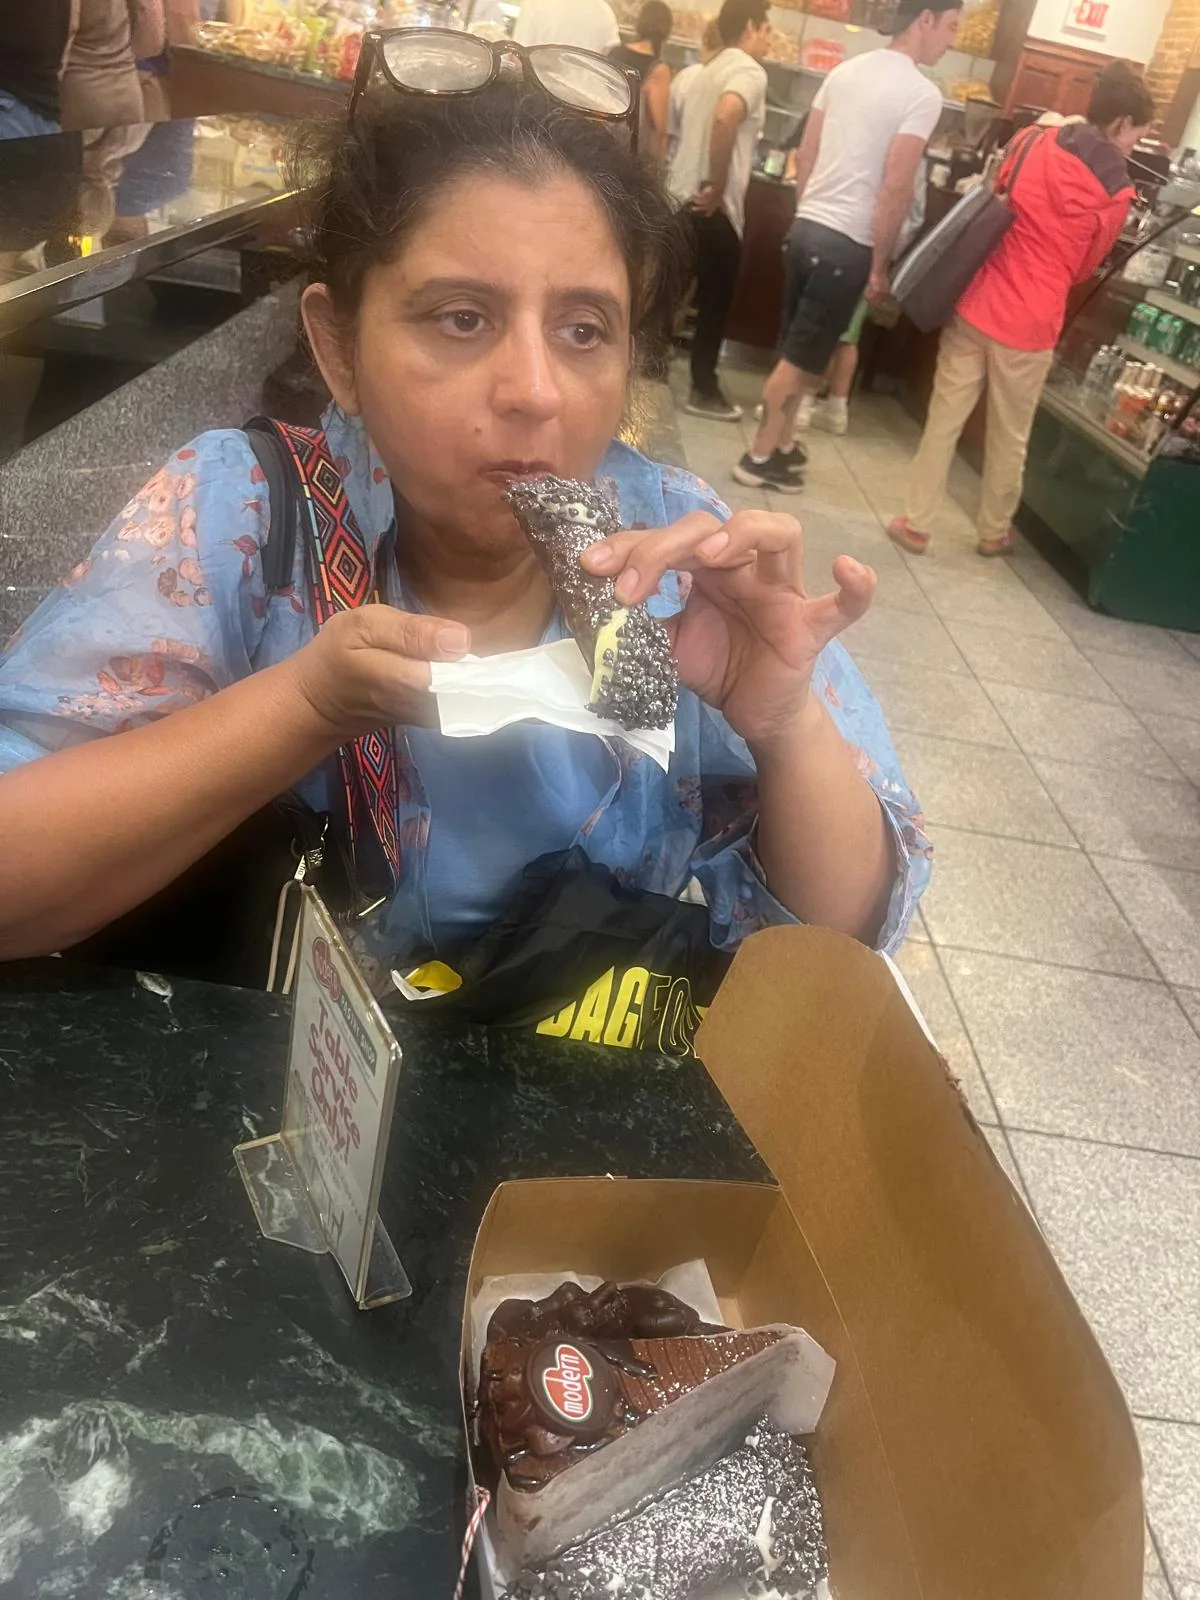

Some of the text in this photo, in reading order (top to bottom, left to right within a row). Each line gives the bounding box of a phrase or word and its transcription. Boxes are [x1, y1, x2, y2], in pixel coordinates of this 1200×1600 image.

[1075, 0, 1109, 28] EXIT
[308, 1022, 361, 1150] Service
[318, 997, 358, 1104] Table
[360, 1035, 376, 1066] SHOP
[311, 1066, 351, 1165] Only!
[546, 1353, 584, 1415] modern
